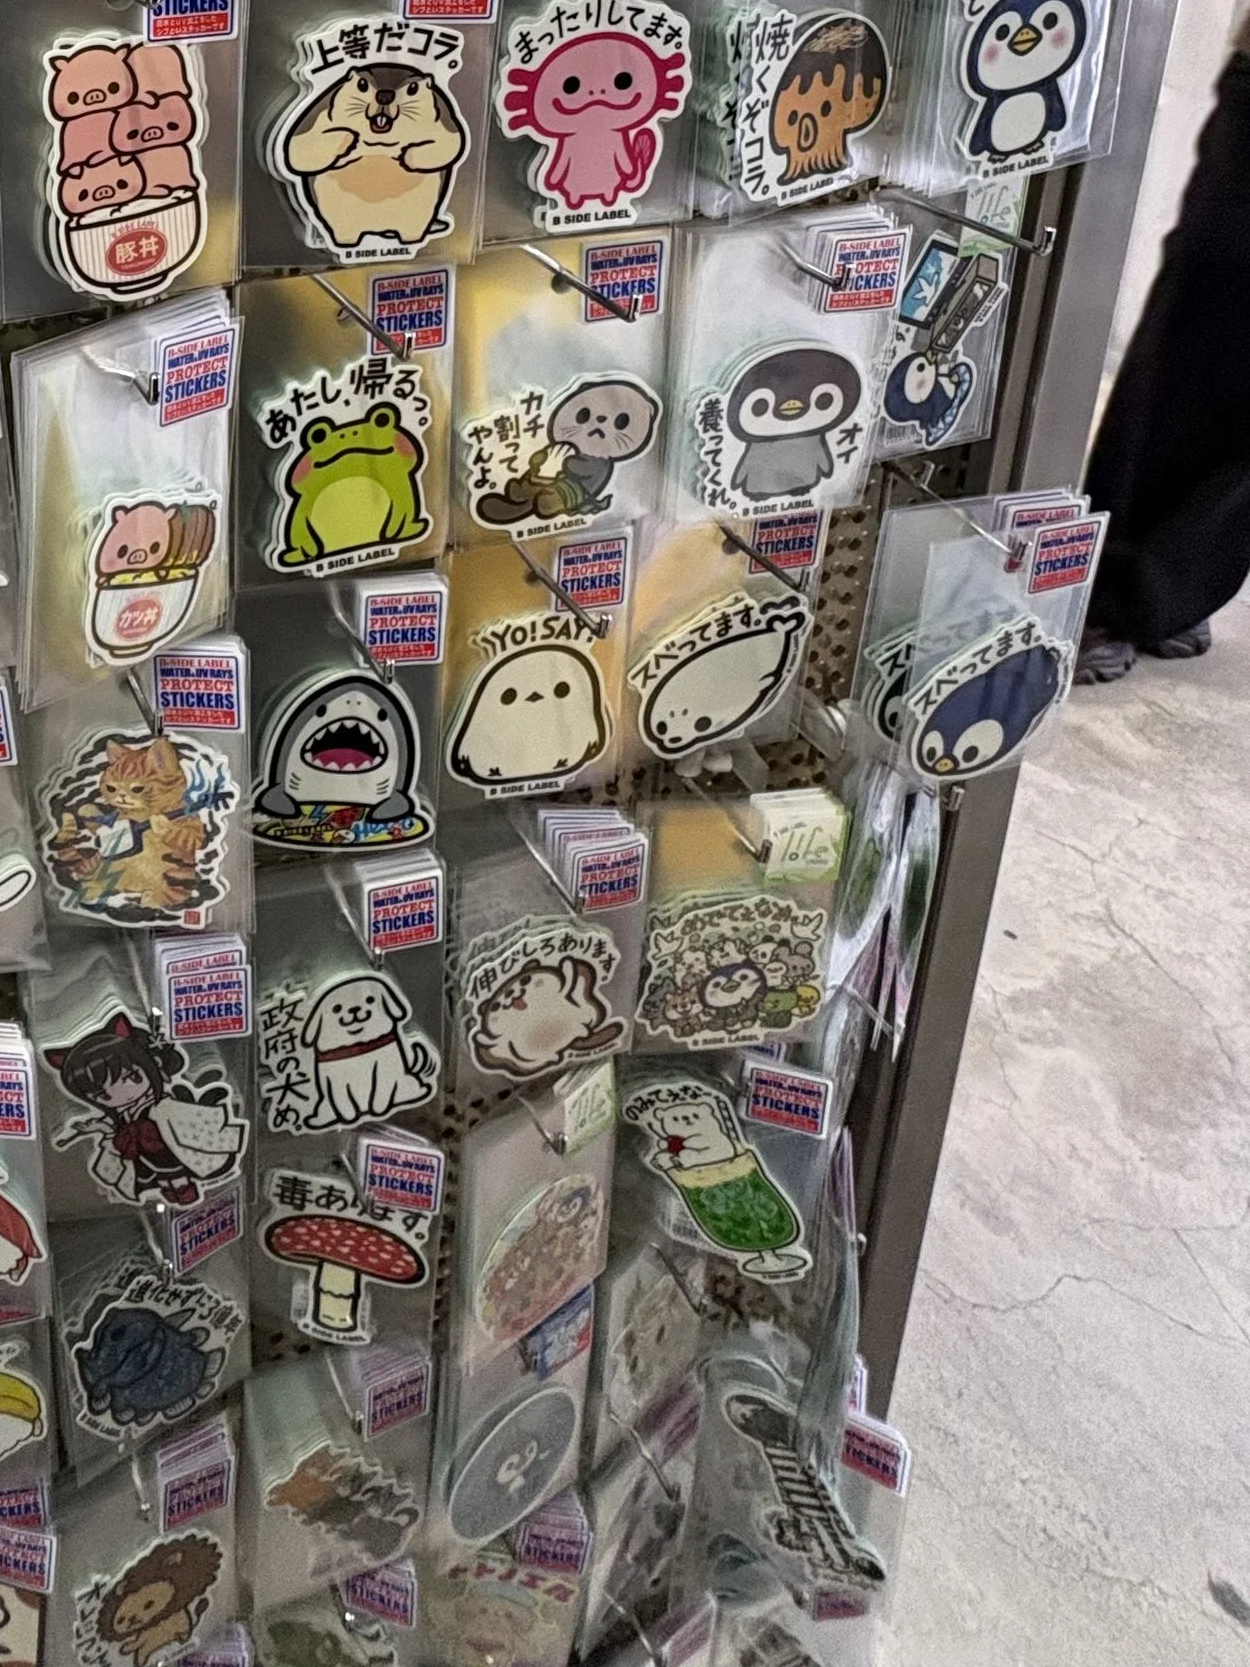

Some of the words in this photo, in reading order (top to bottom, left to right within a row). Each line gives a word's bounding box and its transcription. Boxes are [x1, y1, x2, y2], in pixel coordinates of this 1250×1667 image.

[312, 23, 464, 74] 上等だコラ。
[742, 15, 794, 196] 焼くぞコラ。
[115, 237, 158, 259] 豚丼
[521, 392, 544, 435] カチ
[468, 426, 497, 490] やんよ。
[494, 416, 518, 473] 割って
[700, 400, 737, 510] 養ってくれ。
[837, 424, 863, 464] オイ
[161, 693, 234, 710] STICKERS
[472, 933, 618, 997] 伸びしろあります。
[261, 999, 311, 1131] 政府の犬め。
